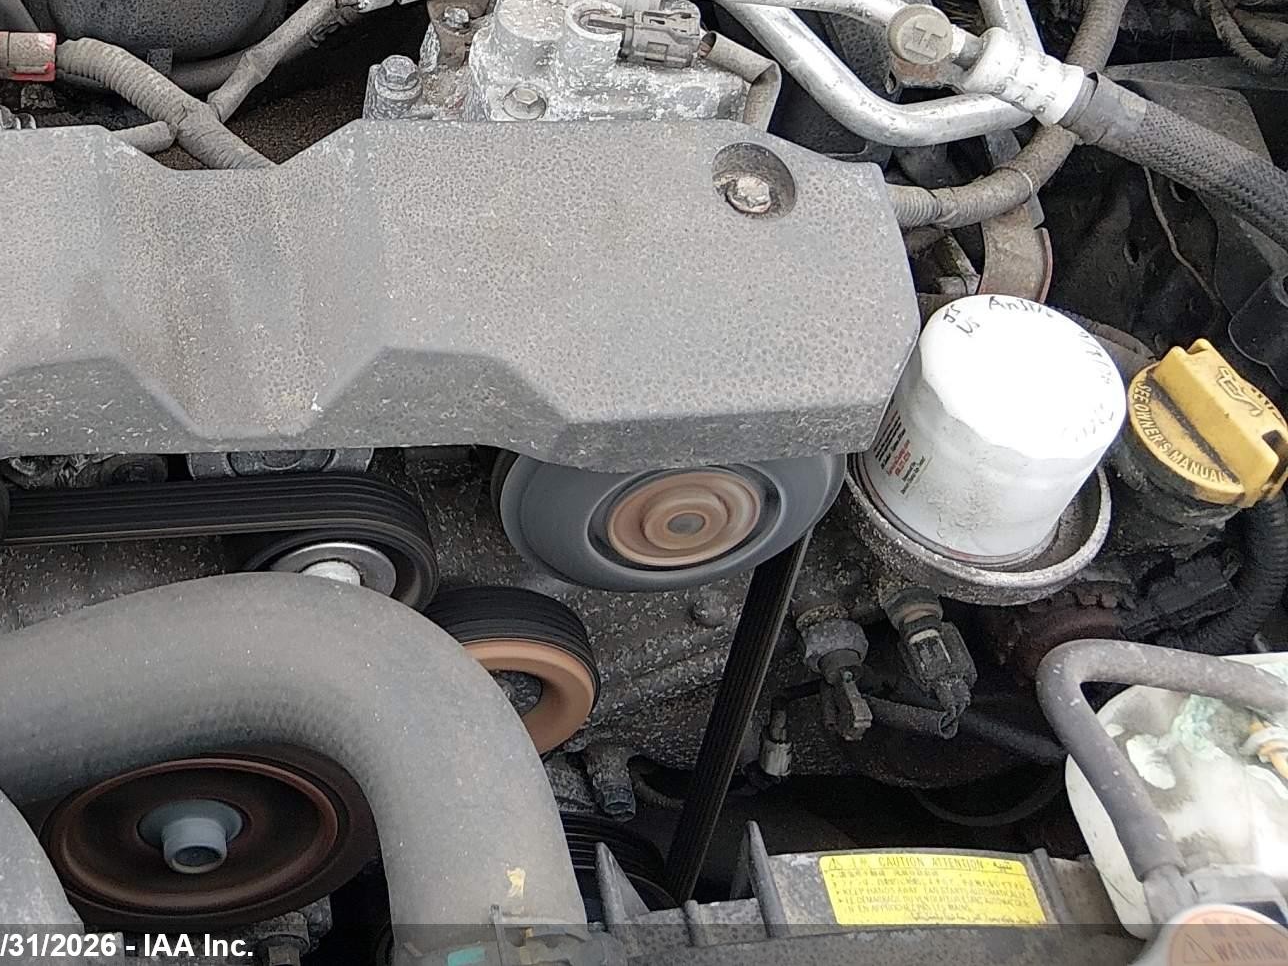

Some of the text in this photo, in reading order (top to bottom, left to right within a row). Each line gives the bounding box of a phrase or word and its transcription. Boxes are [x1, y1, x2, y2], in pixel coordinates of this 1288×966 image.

[1133, 381, 1229, 484] SEE OWNER'S MANUAL
[878, 856, 925, 867] CAUTION
[932, 857, 984, 870] ATTENTION
